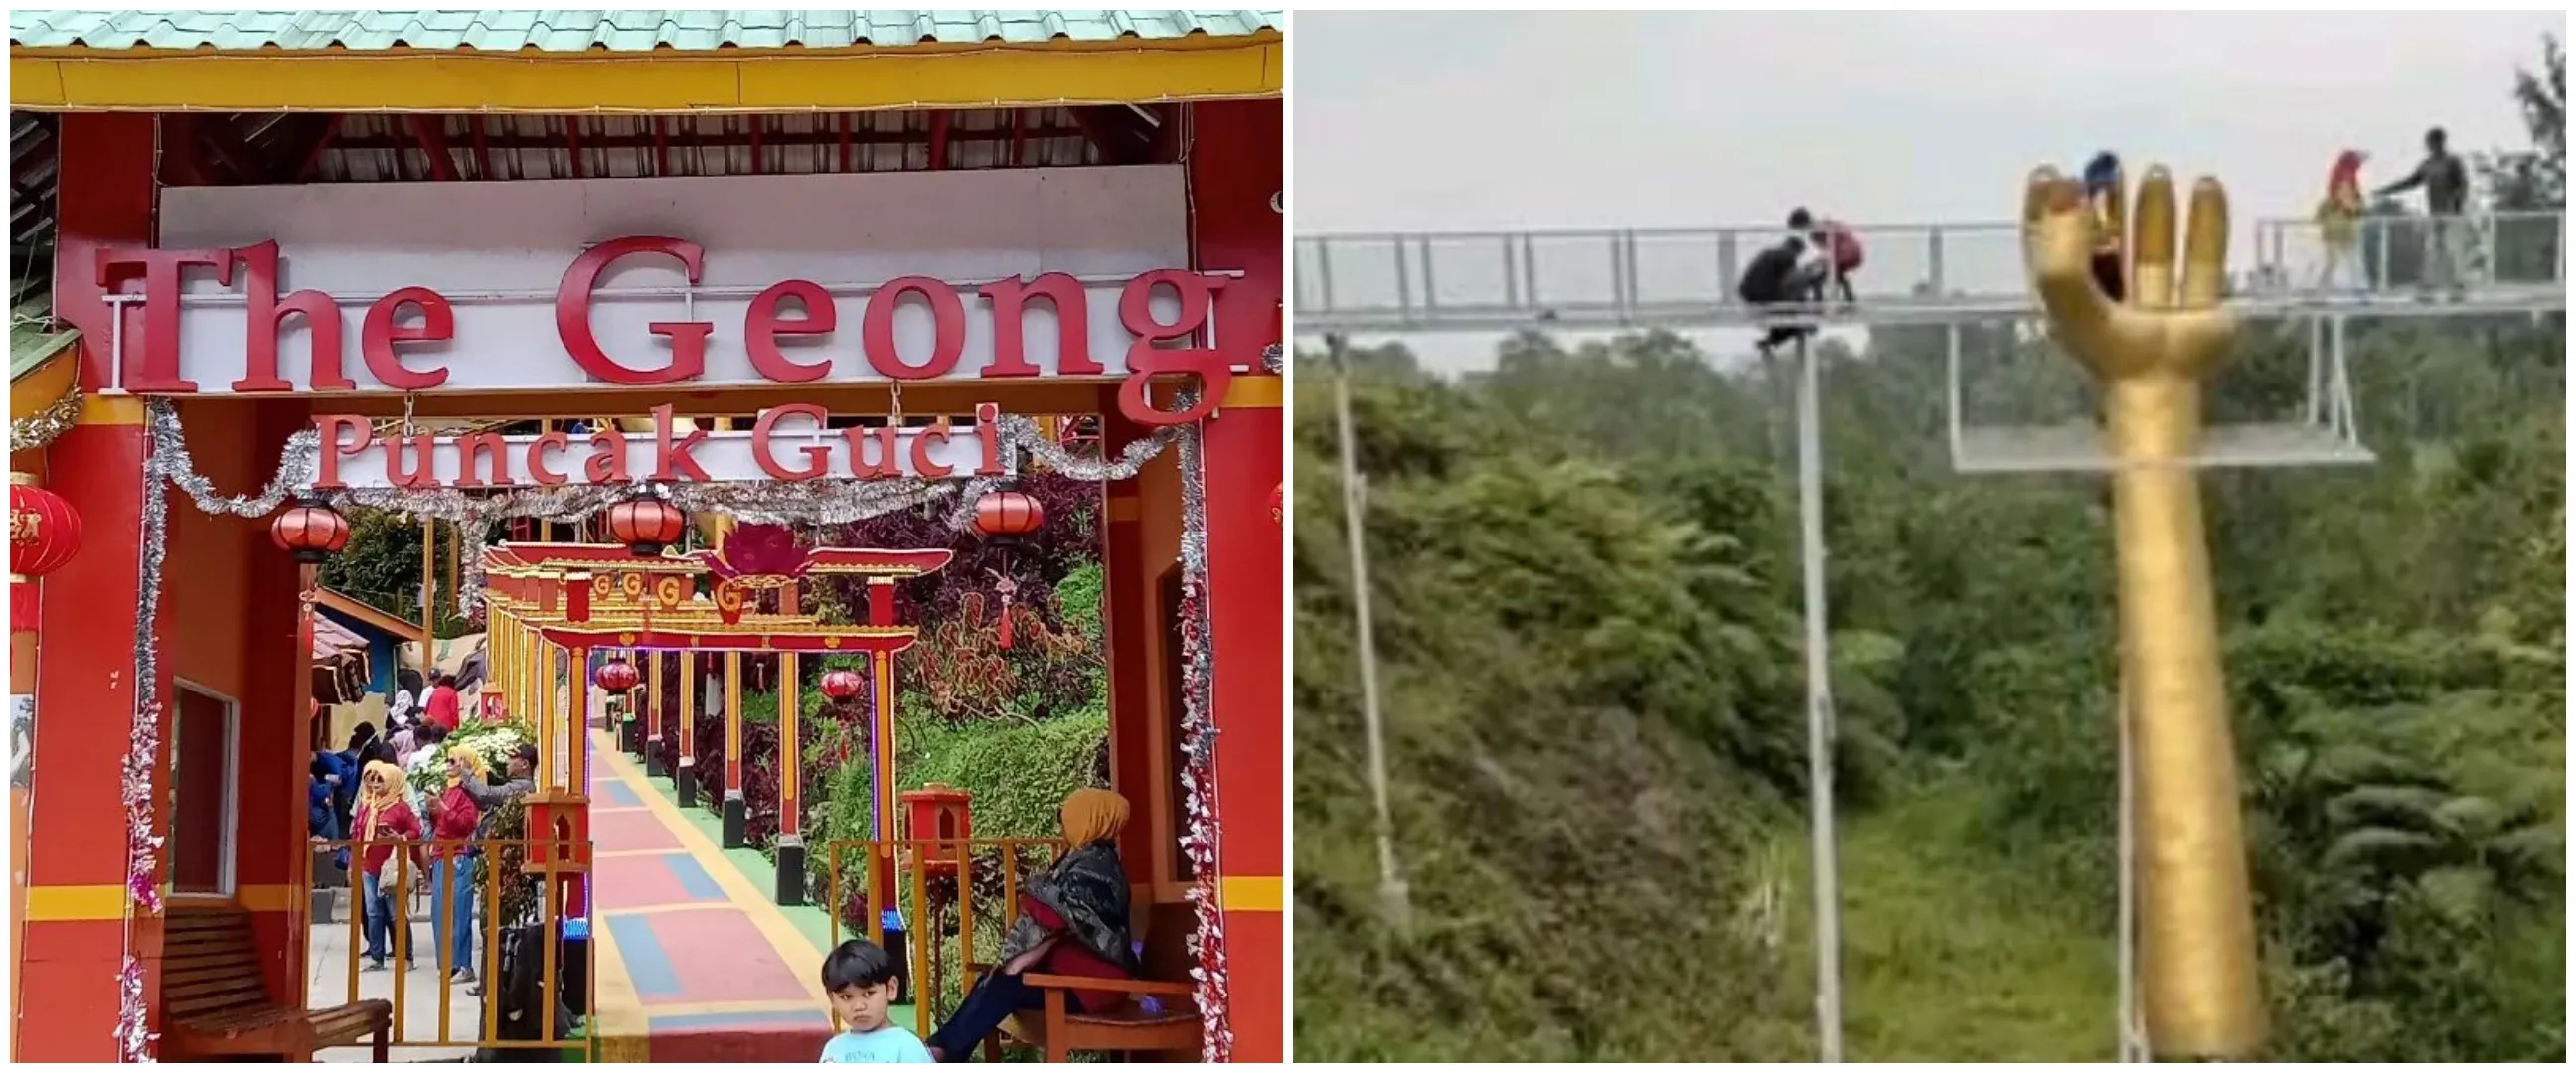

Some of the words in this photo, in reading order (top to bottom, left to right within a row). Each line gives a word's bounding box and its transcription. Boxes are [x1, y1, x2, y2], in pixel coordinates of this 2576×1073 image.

[95, 239, 454, 392] The
[556, 235, 1236, 425] Geong
[311, 403, 710, 489] Puncak
[751, 403, 1006, 481] Guci
[593, 574, 610, 595] G
[622, 572, 641, 596] G
[658, 577, 680, 606] G
[717, 579, 743, 612] G
